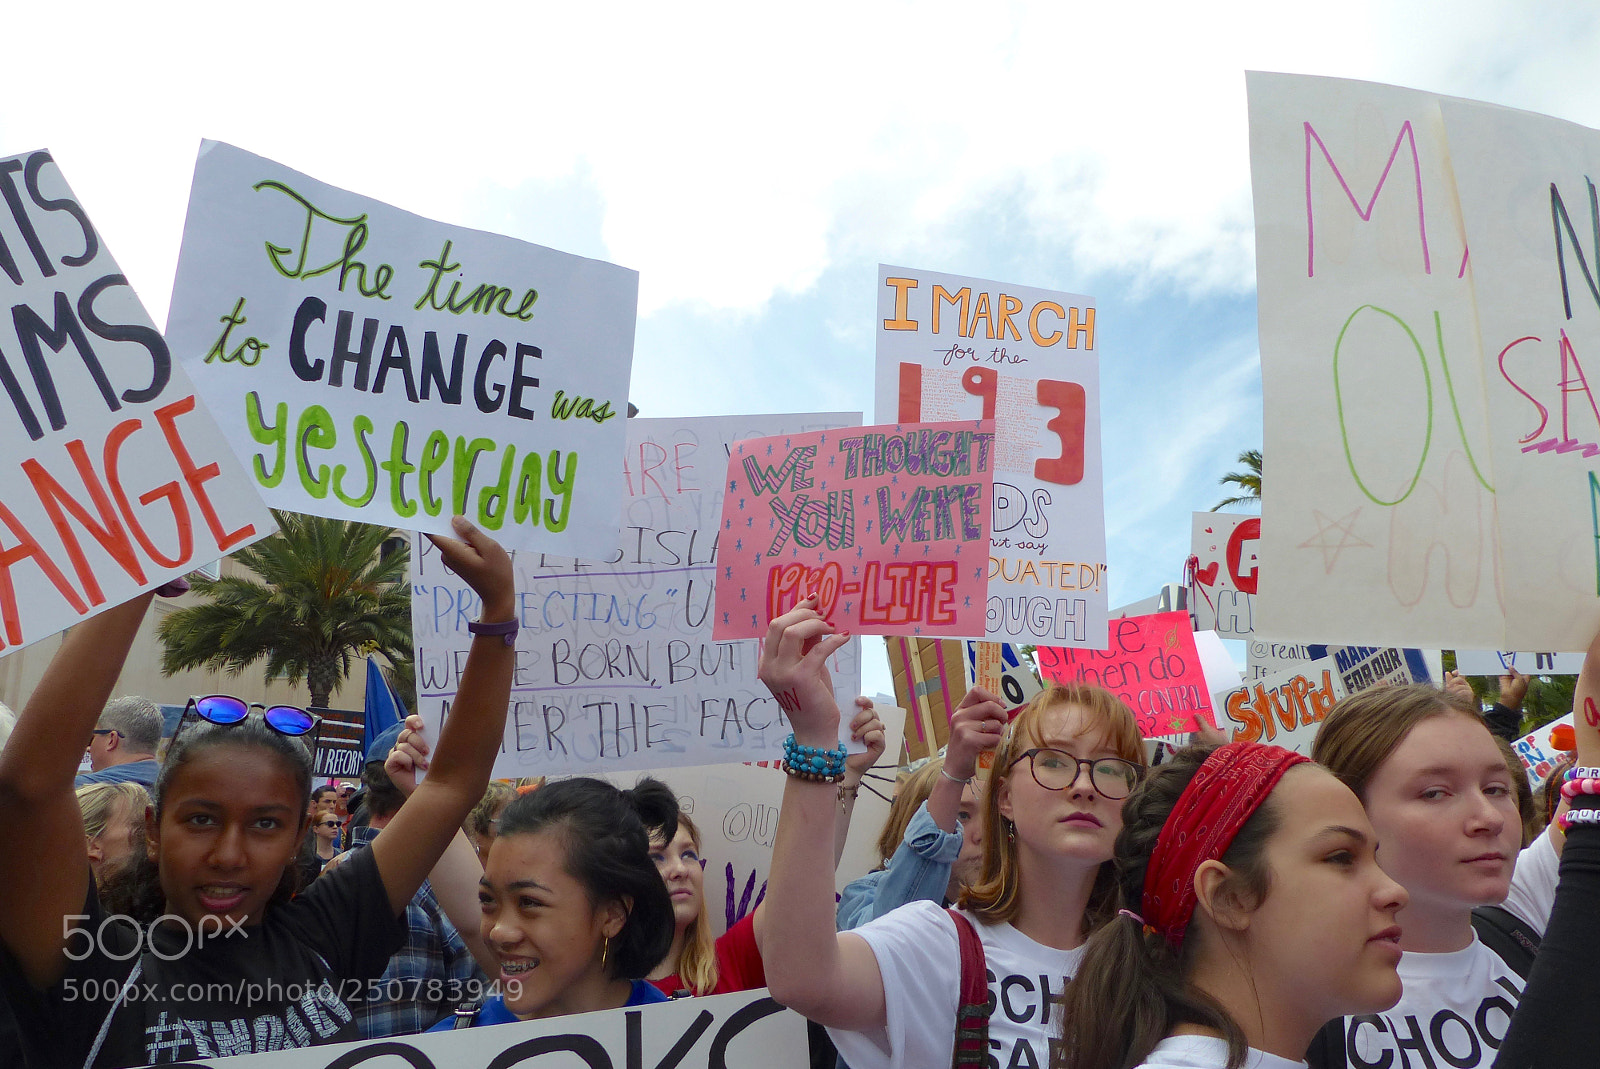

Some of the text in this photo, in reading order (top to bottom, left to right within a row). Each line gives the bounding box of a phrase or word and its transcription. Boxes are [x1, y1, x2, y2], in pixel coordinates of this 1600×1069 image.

[252, 179, 540, 321] The time
[884, 277, 1096, 351] I MARCH
[204, 296, 617, 424] to CHANGE was
[933, 343, 1029, 367] for the
[245, 391, 578, 533] yesterday
[742, 429, 995, 497] WE THOUGHT
[766, 483, 982, 558] YOU WERE
[1015, 541, 1049, 556] say
[766, 560, 959, 627] PRO-LIFE
[550, 636, 657, 687] BORN,
[667, 641, 745, 685] BUT
[1148, 647, 1186, 682] do
[1342, 663, 1376, 694] FOR
[1370, 648, 1403, 680] OUR
[583, 702, 680, 758] THE
[1138, 684, 1210, 716] CONTROL
